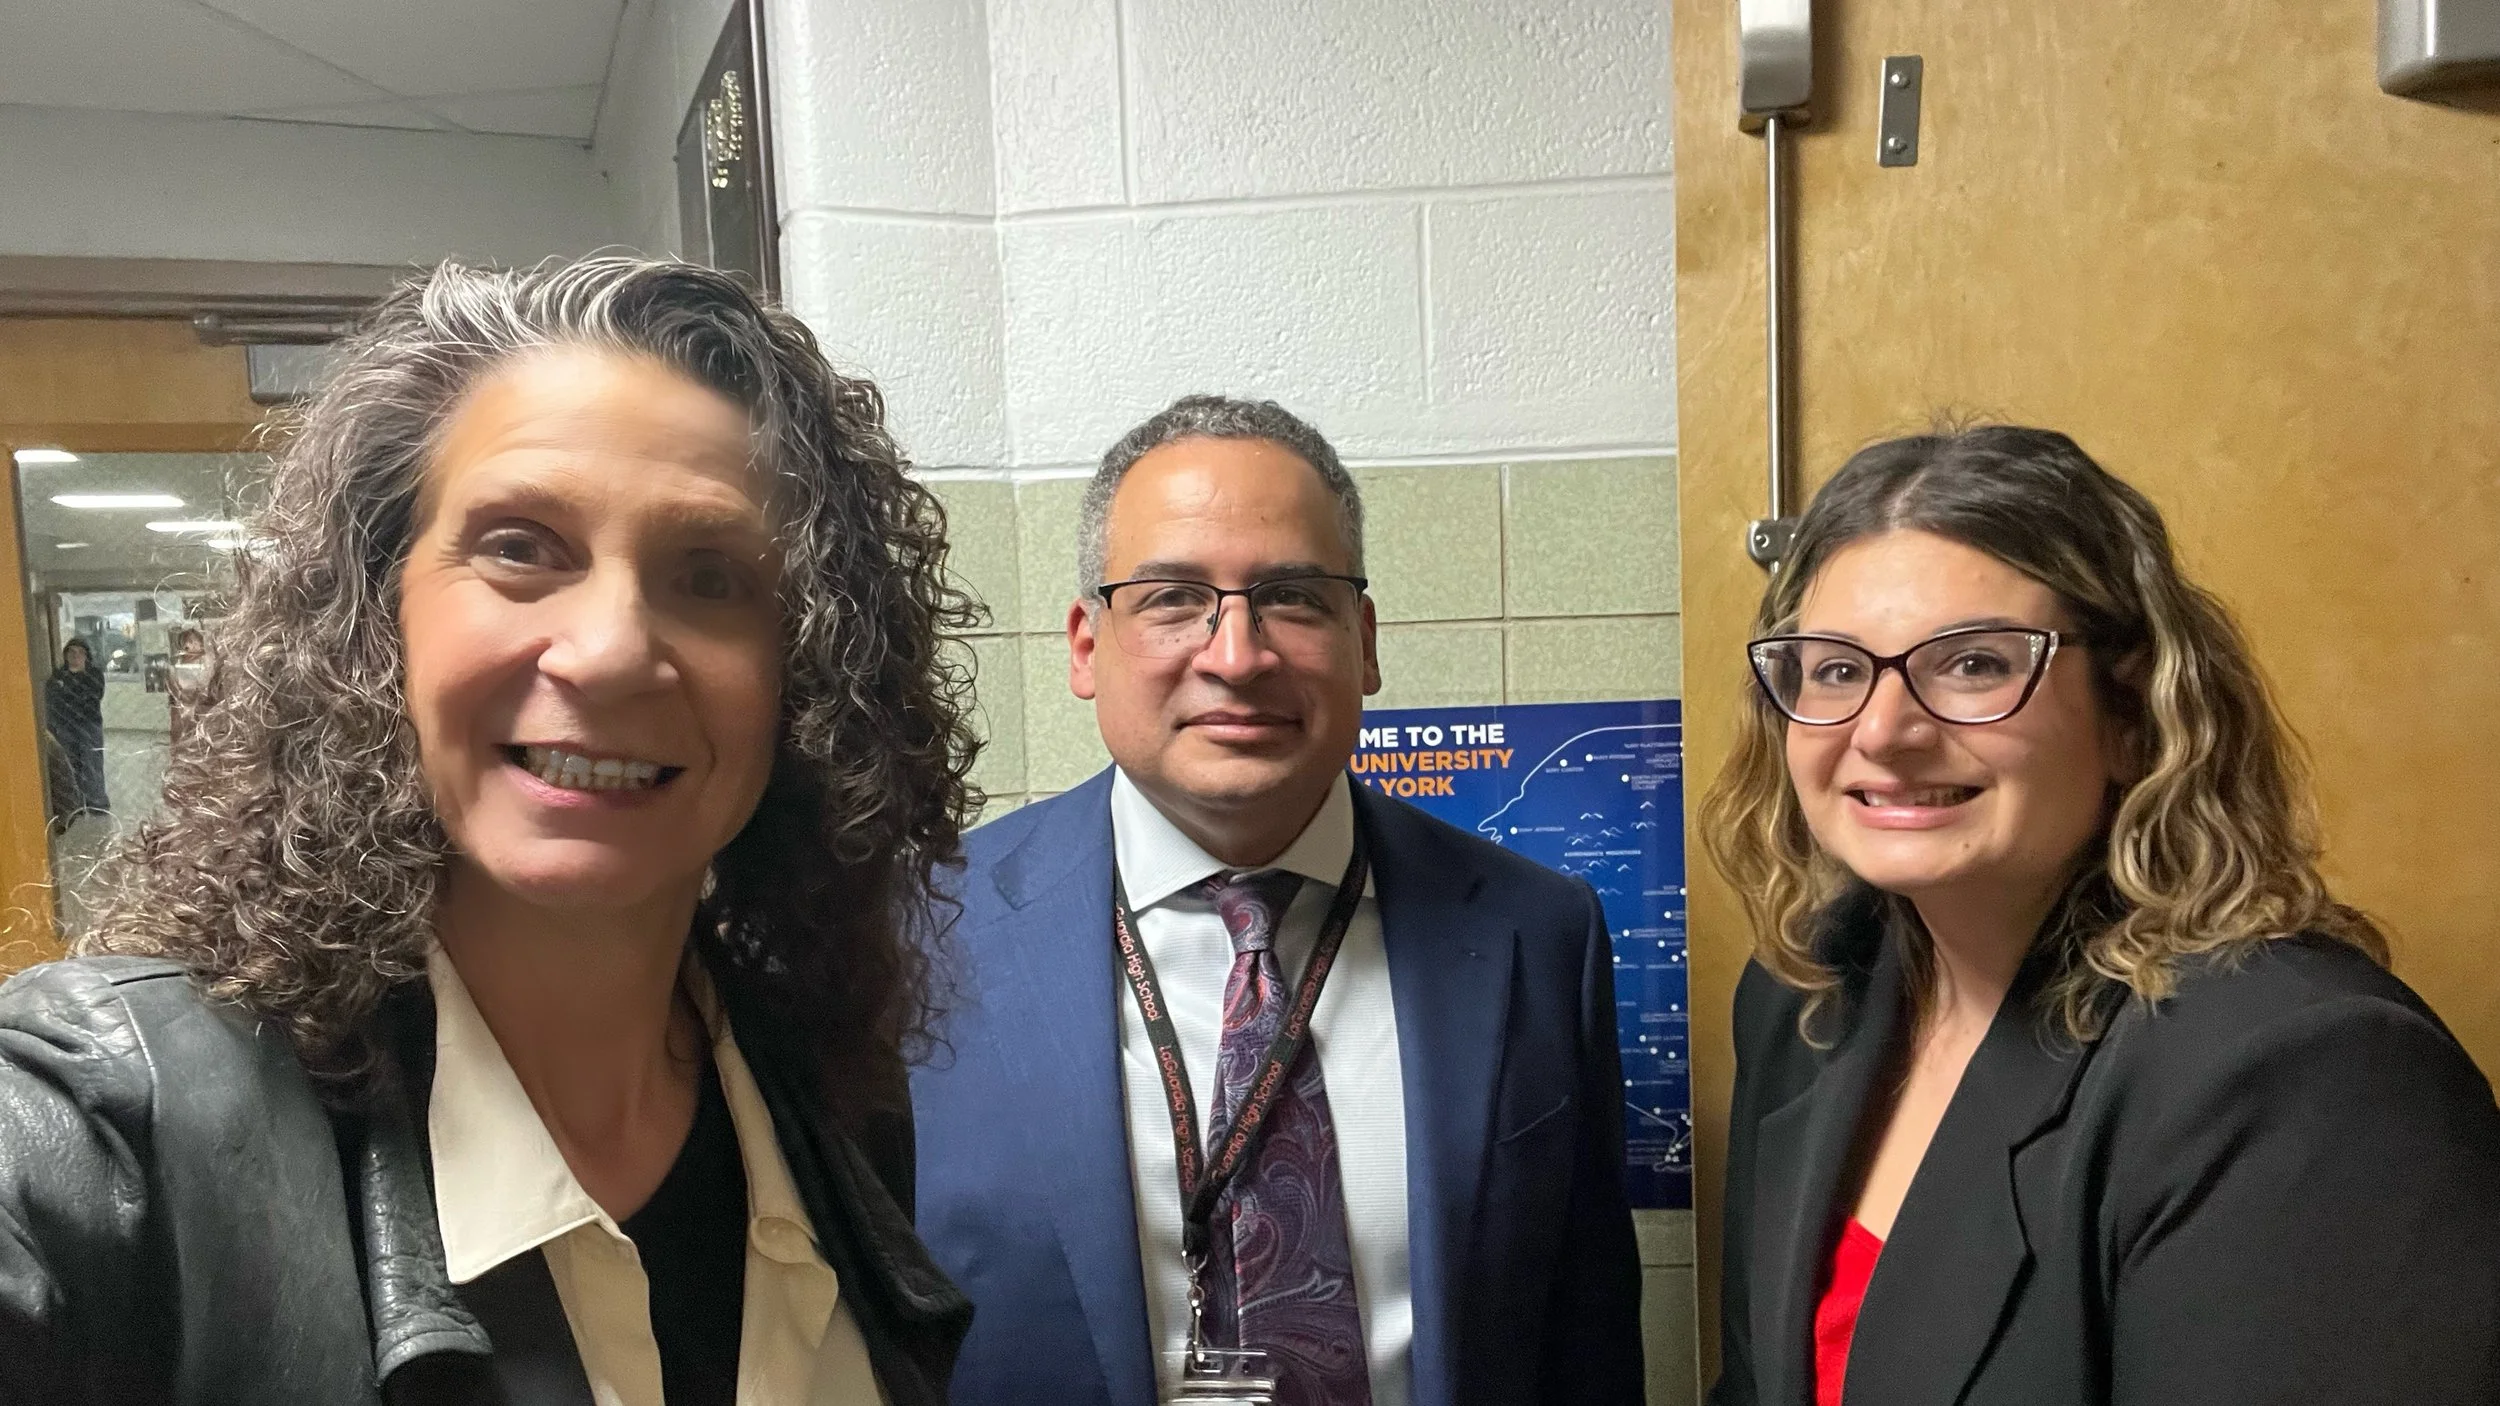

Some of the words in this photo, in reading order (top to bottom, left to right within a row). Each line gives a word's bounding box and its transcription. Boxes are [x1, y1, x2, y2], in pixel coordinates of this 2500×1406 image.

[1405, 725, 1444, 747] TO
[1450, 723, 1505, 746] THE
[1350, 748, 1514, 774] UNIVERSITY
[1379, 776, 1456, 798] YORK
[1126, 952, 1146, 982] High
[1136, 980, 1163, 1022] School
[1252, 1059, 1284, 1103] School
